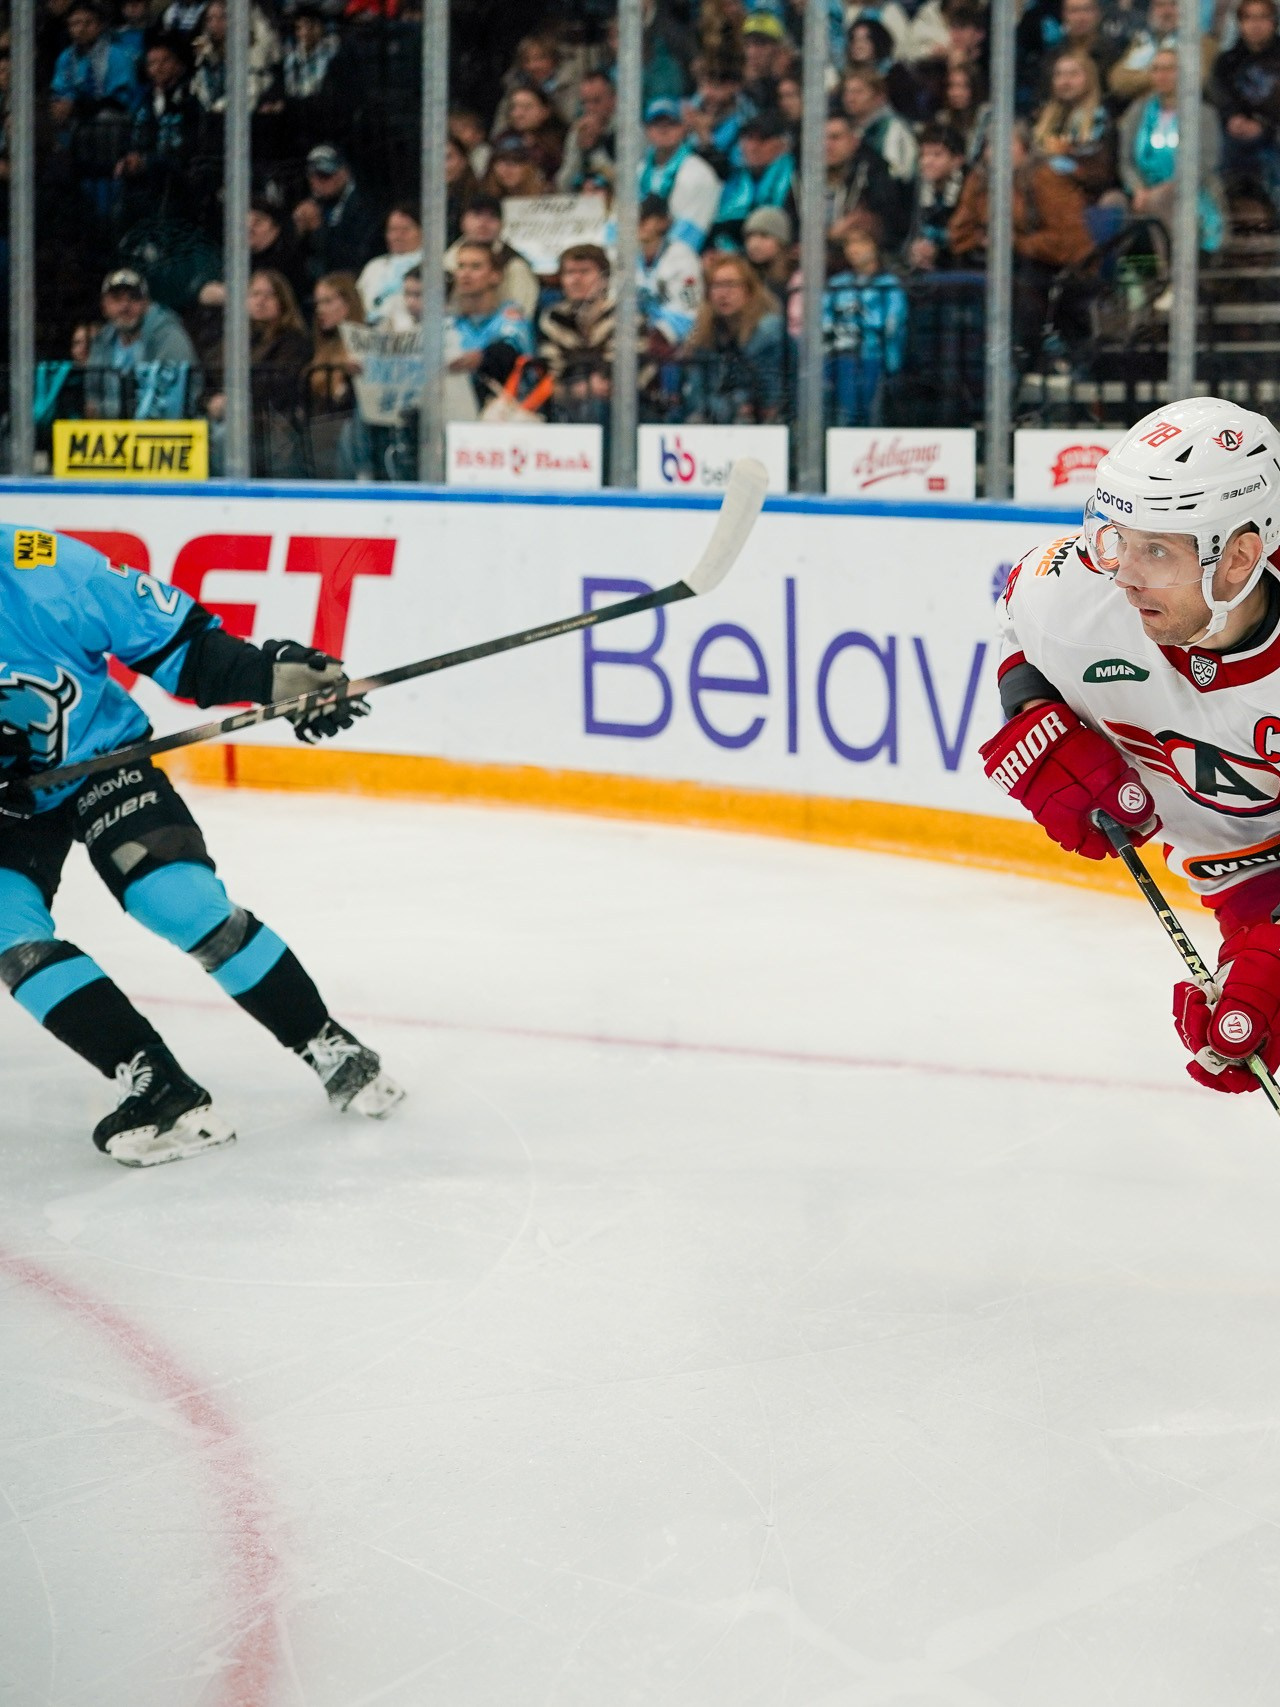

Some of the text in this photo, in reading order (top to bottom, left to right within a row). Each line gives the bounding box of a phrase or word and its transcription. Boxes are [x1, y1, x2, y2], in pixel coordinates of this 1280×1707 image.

[69, 433, 192, 471] MAX LINE
[1139, 422, 1182, 448] 78
[18, 534, 35, 561] MAX
[988, 710, 1069, 796] RRIOR
[77, 767, 144, 816] Belavia
